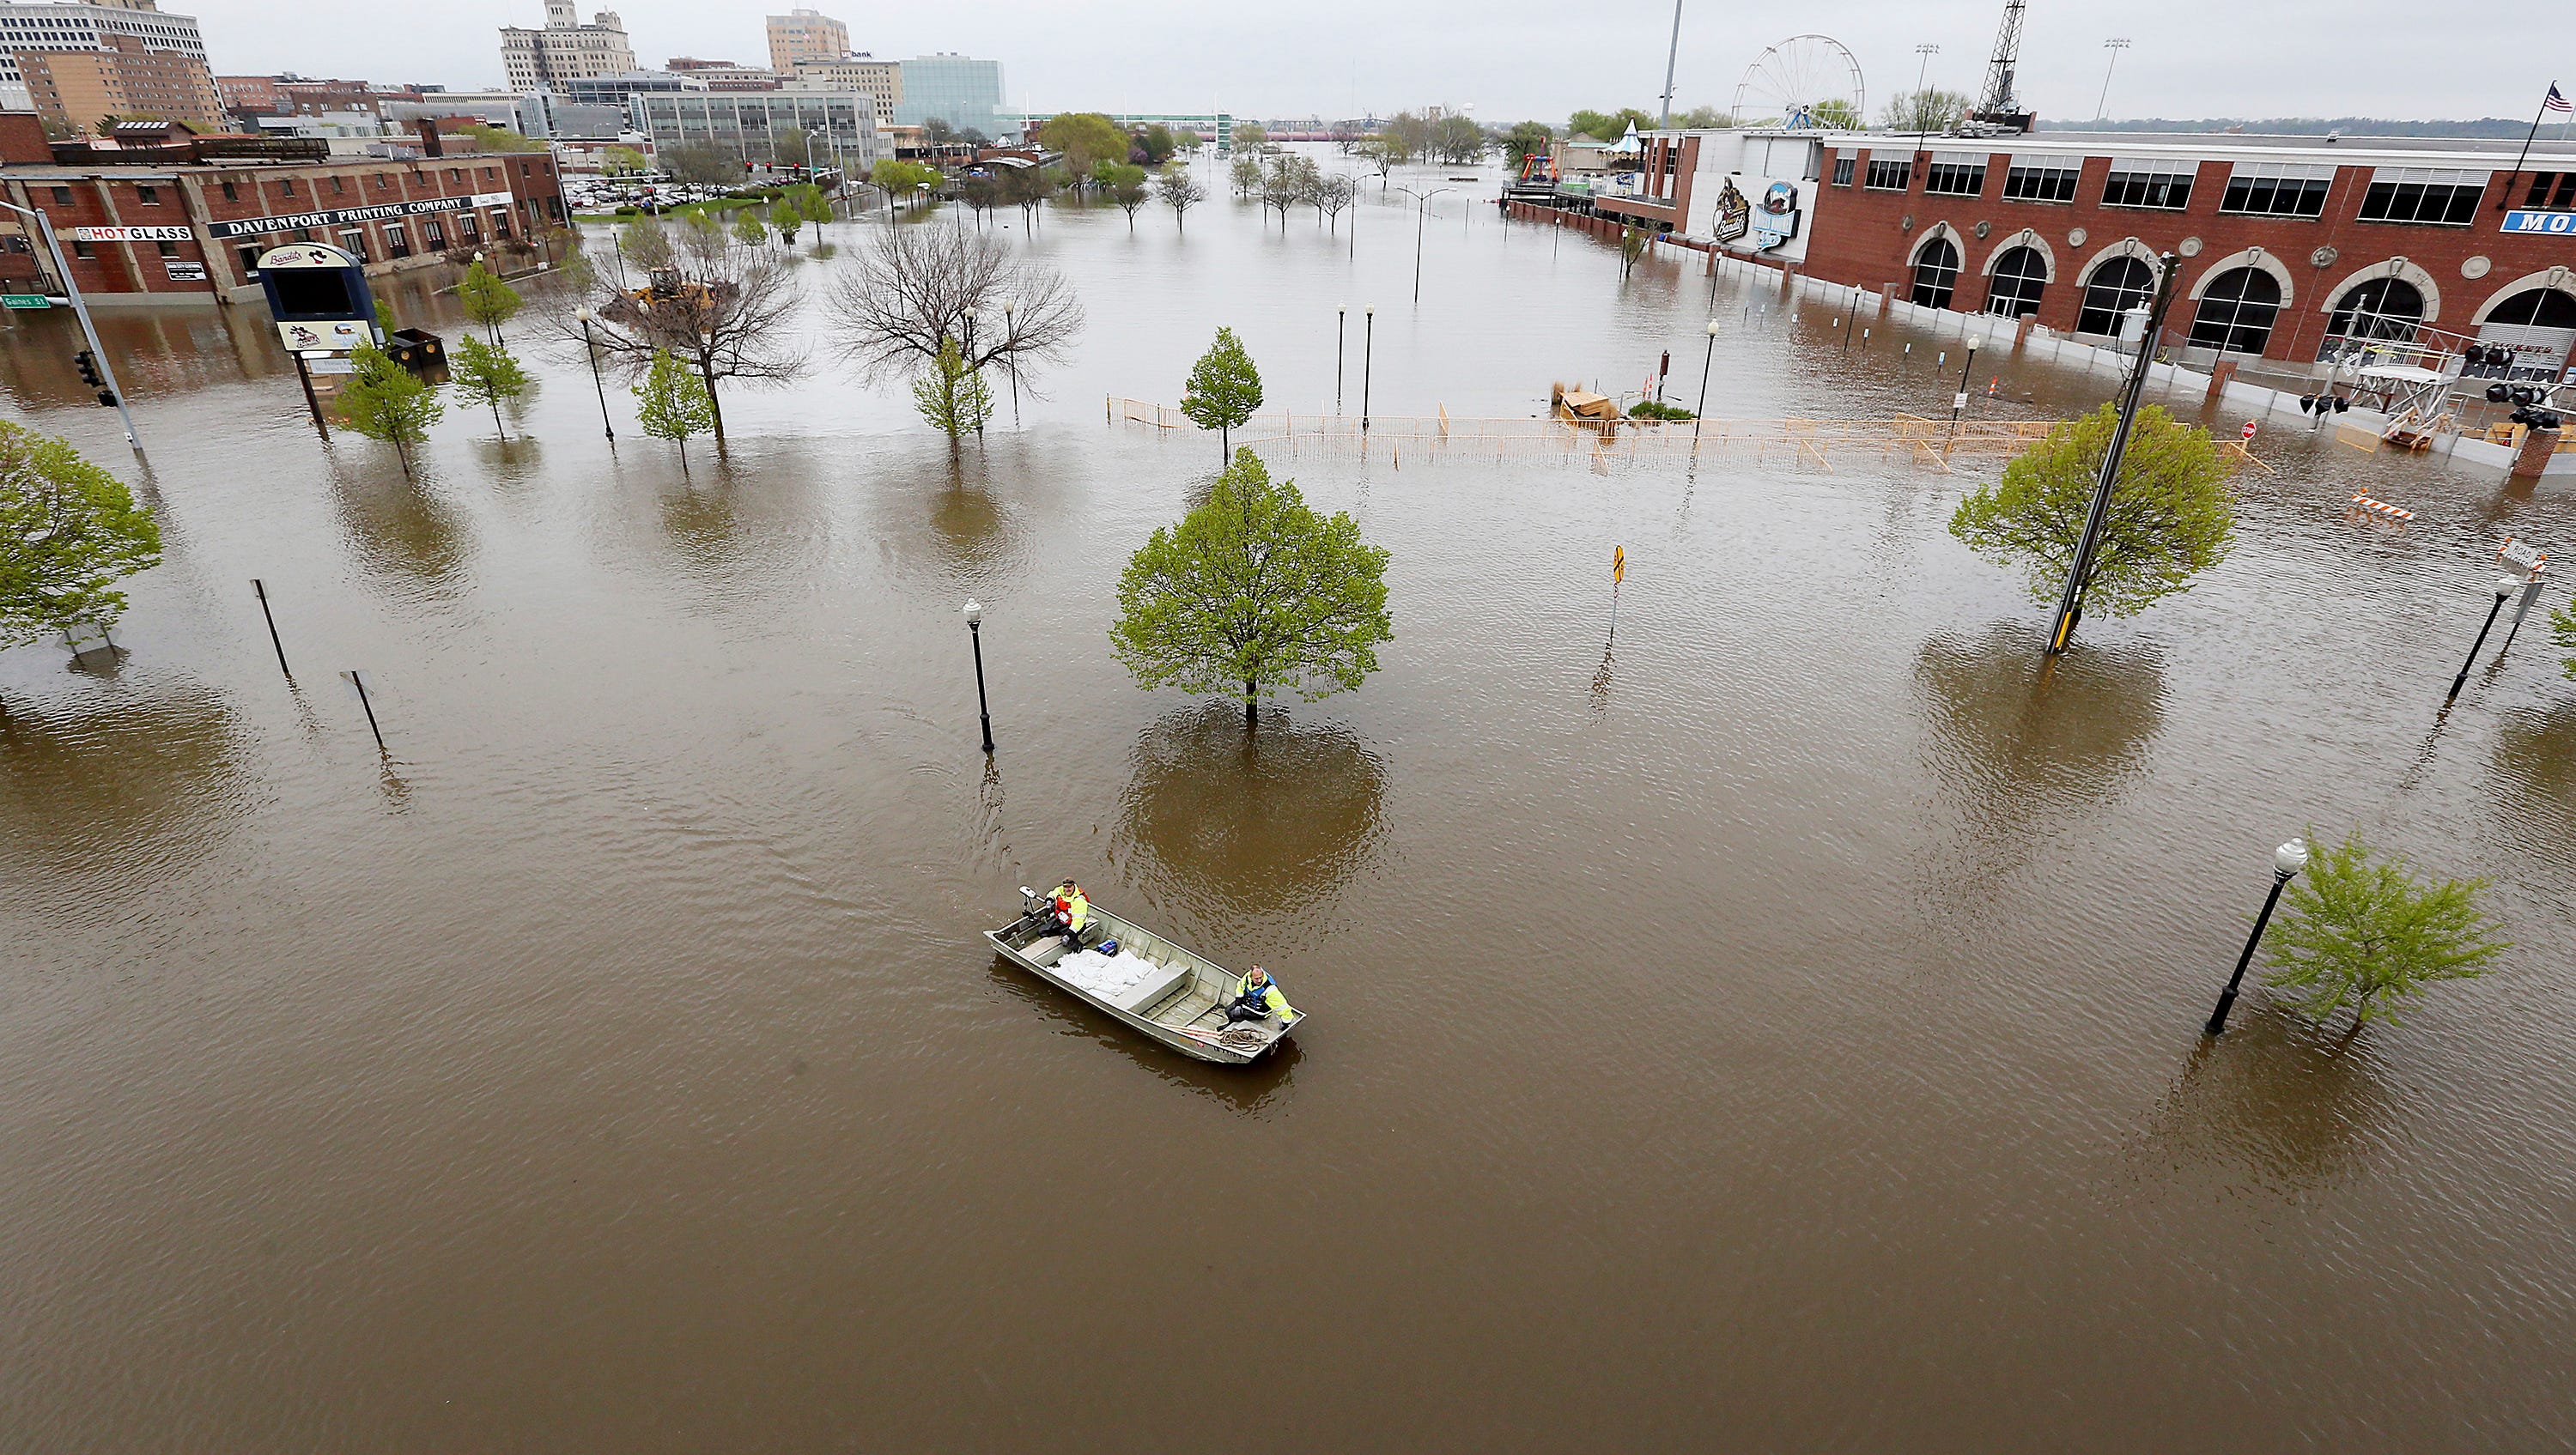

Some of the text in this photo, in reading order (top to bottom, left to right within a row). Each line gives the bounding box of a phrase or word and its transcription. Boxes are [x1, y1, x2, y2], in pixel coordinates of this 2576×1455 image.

[228, 198, 462, 234] DAVENPORT PRINTING COMPANY
[1717, 215, 1745, 236] Bandits
[2518, 214, 2576, 233] MO
[91, 227, 189, 239] HOT GLASS
[270, 250, 302, 264] Bandits
[5, 297, 32, 306] Gaines
[2513, 545, 2531, 558] ROAD
